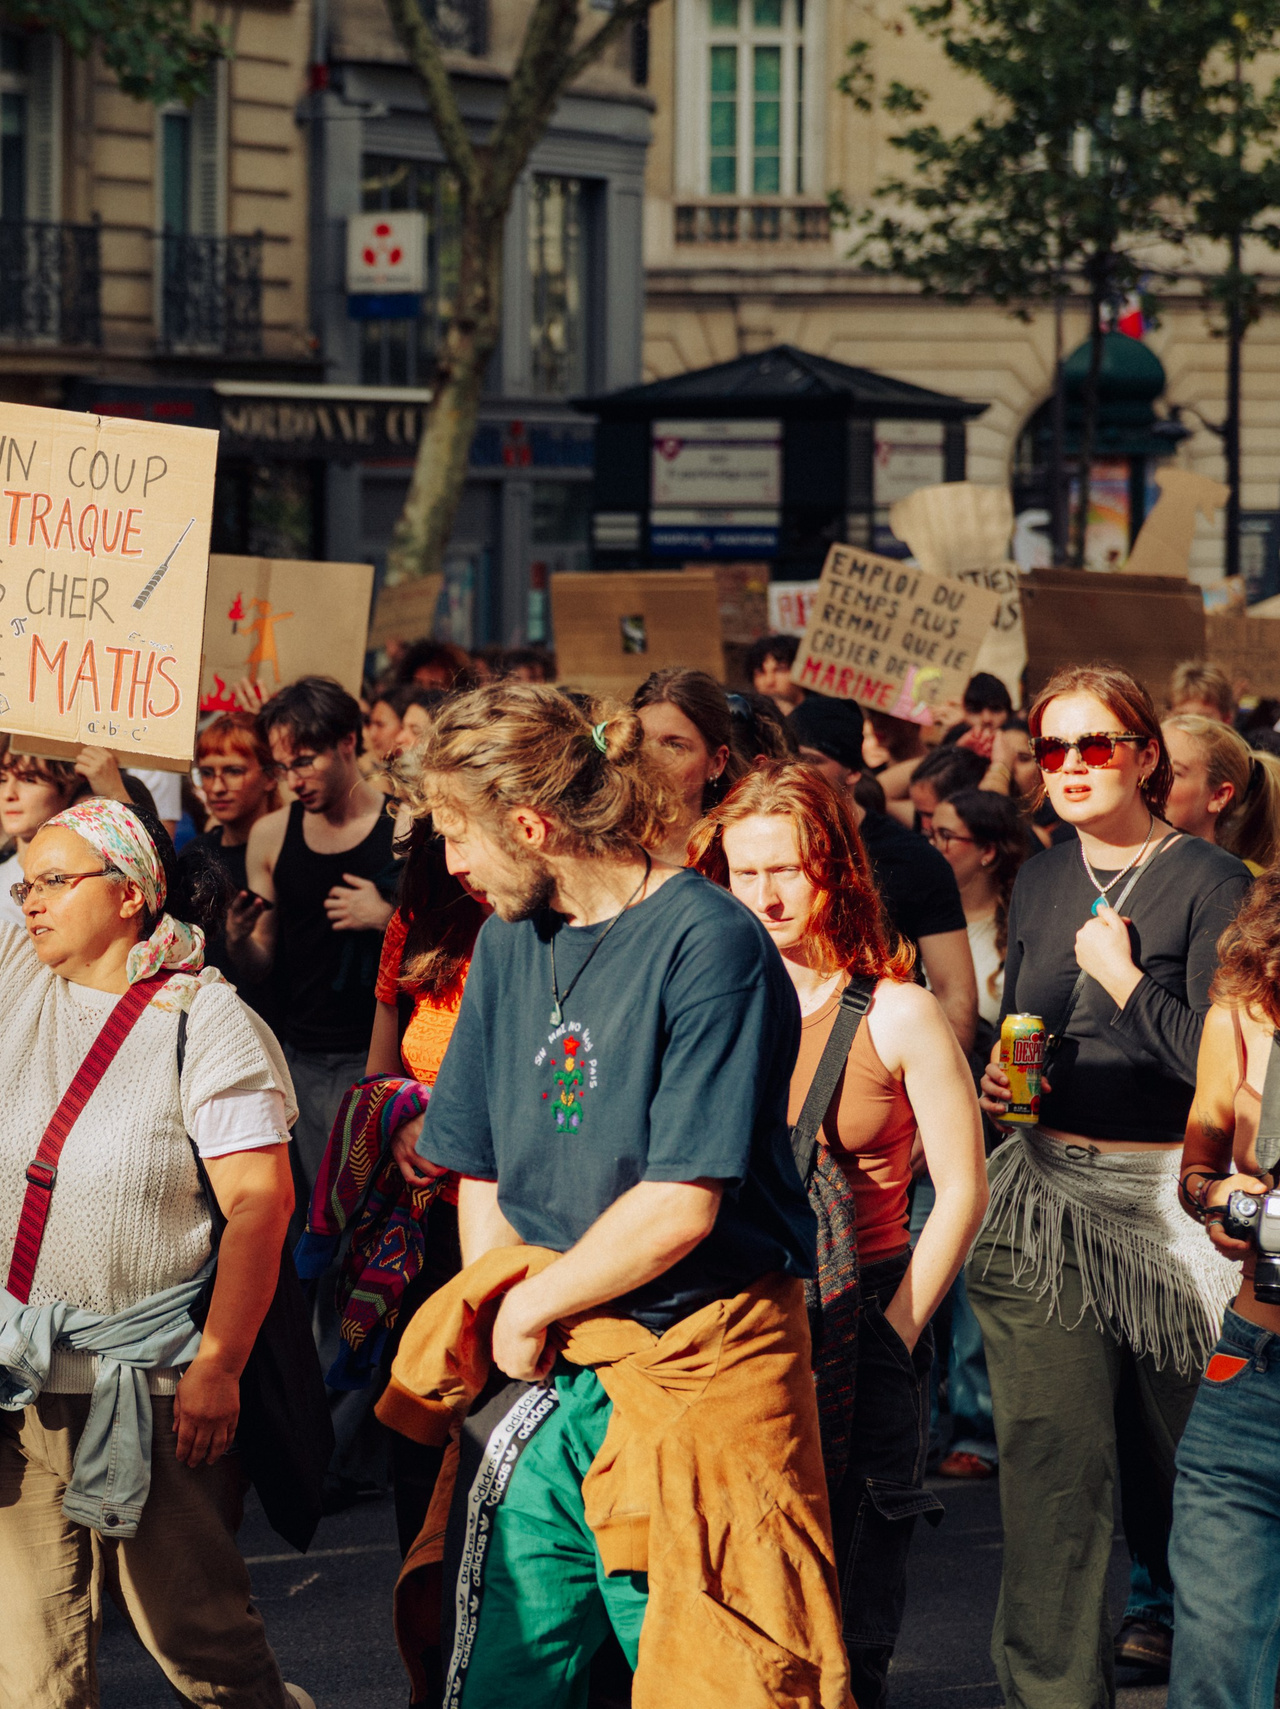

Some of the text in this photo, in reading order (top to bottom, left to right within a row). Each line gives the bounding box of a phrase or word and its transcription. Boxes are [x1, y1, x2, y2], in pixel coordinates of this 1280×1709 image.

[68, 446, 168, 498] COUP
[25, 567, 116, 624] CHER
[830, 552, 966, 612] EMPLOI DU
[822, 604, 892, 644] REMPLI
[902, 631, 940, 663] QUE
[827, 579, 900, 620] TEMPS
[911, 606, 961, 640] PLUS
[810, 630, 881, 668] CASIER
[28, 633, 183, 720] MATHS
[800, 655, 895, 707] MARINE
[534, 1047, 547, 1066] SIN
[568, 1021, 582, 1032] NO
[504, 1391, 538, 1433] adidas
[517, 1398, 554, 1440] adidas
[472, 1457, 498, 1503] adidas
[472, 1534, 488, 1587] adidas
[452, 1613, 468, 1666] adidas
[460, 1616, 477, 1670] adidas
